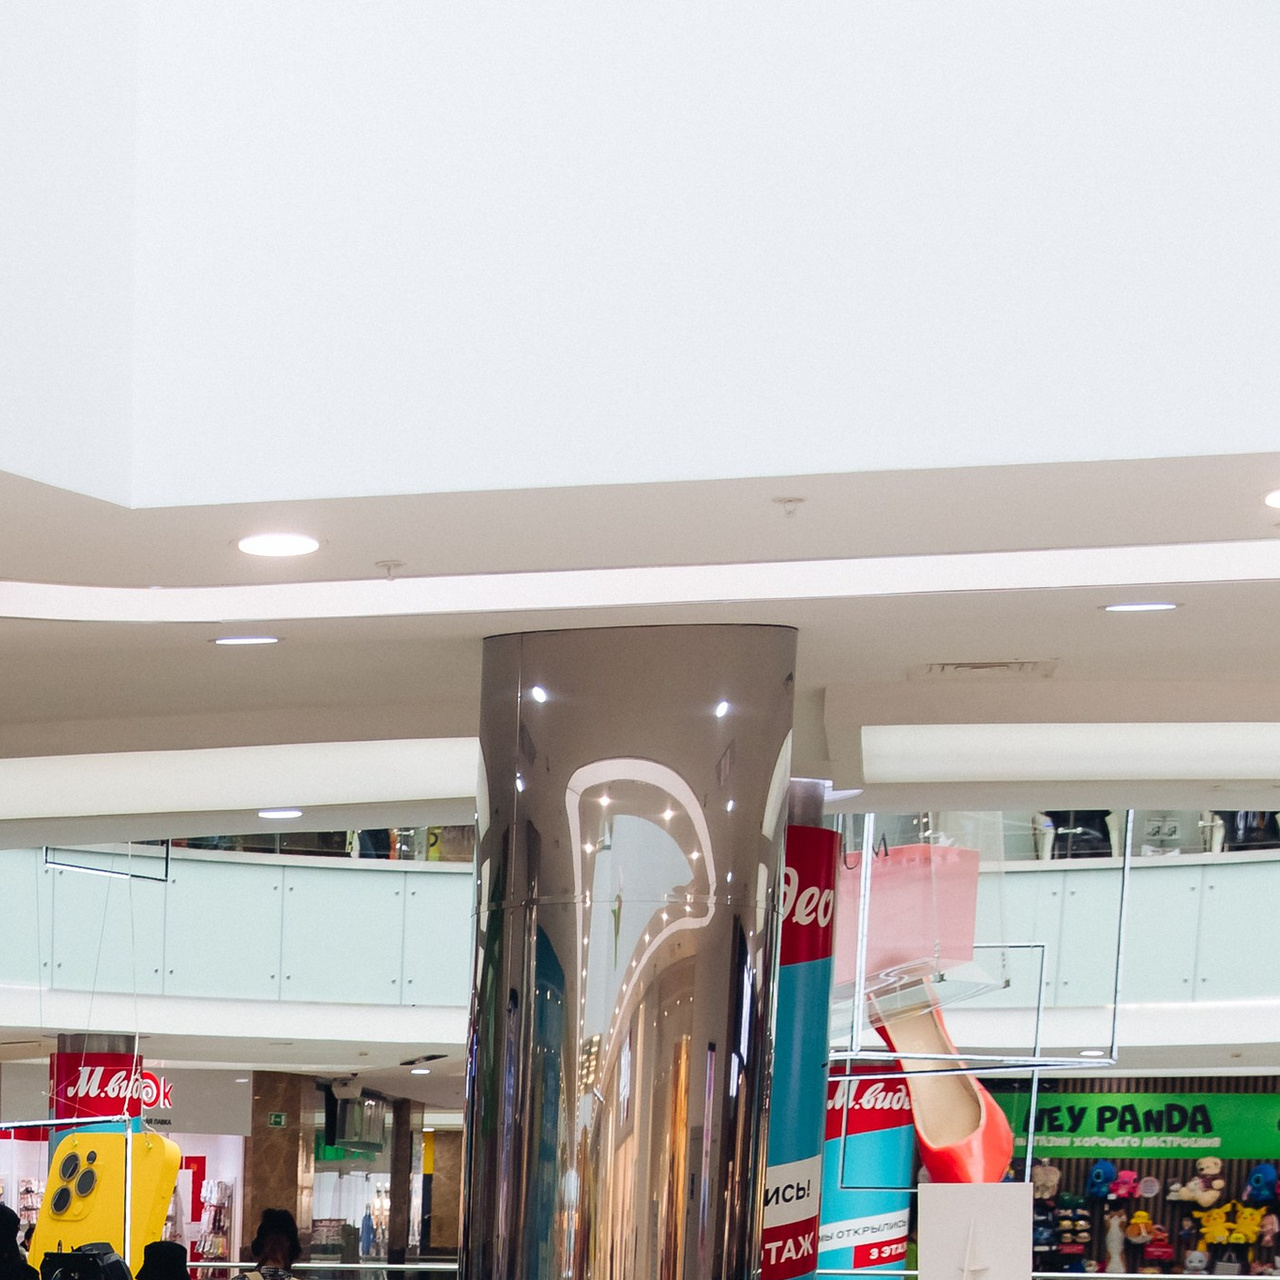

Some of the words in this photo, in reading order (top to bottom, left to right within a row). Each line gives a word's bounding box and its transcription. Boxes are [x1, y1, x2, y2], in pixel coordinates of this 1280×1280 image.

[1096, 1103, 1213, 1134] PANDA
[761, 1231, 814, 1265] ТАЖ
[869, 1247, 879, 1260] 3
